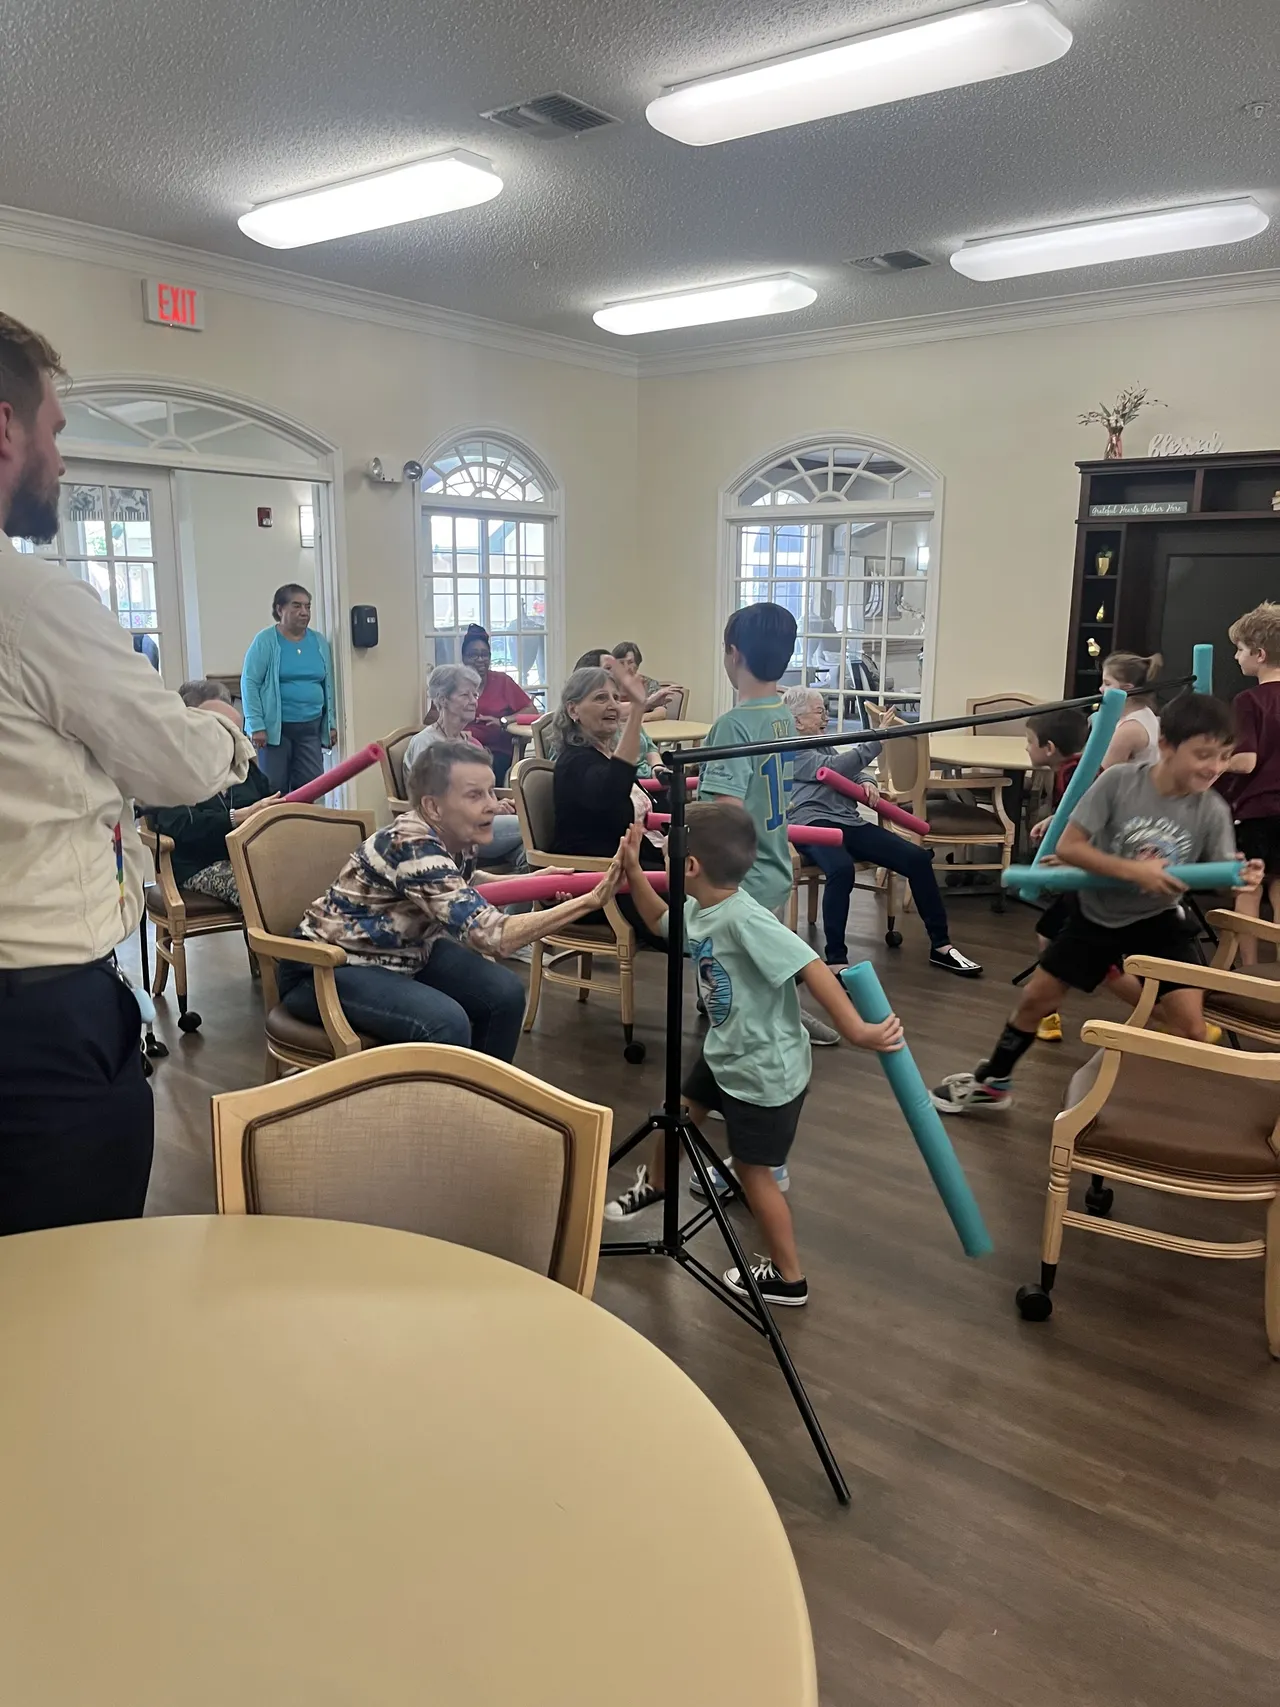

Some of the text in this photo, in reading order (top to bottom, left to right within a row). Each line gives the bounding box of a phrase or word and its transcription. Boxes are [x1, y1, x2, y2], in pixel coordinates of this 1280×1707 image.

[158, 283, 197, 326] EXIT
[1091, 503, 1182, 516] Grateful Hearts Gather Here
